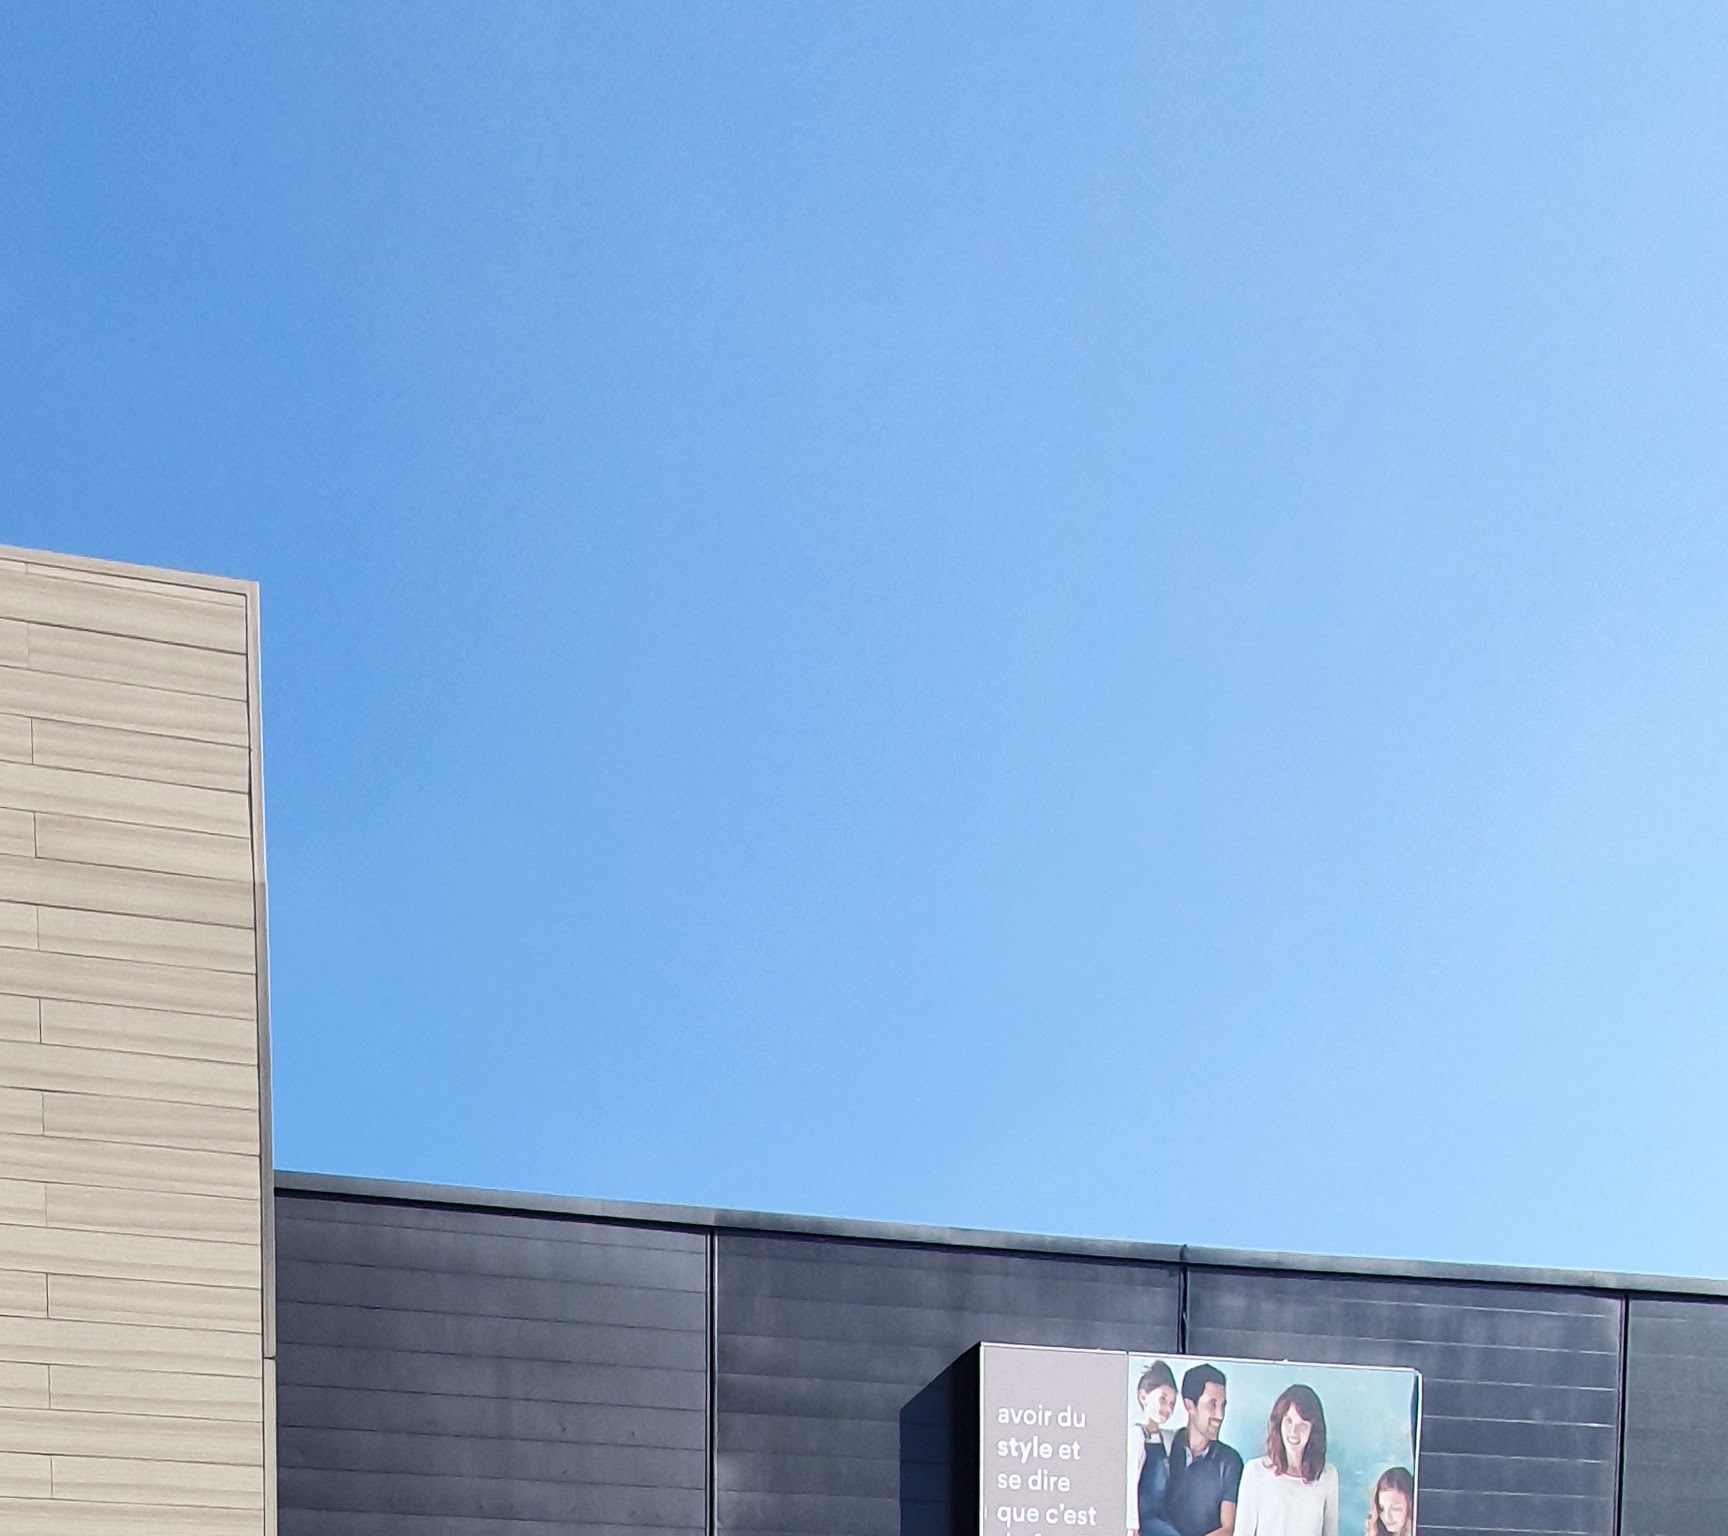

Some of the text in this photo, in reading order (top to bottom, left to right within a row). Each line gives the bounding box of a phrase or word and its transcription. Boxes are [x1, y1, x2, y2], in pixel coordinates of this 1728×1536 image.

[997, 1404, 1086, 1428] avoir du
[997, 1435, 1081, 1464] style et
[997, 1469, 1071, 1492] se dire
[997, 1503, 1097, 1529] que c'est
